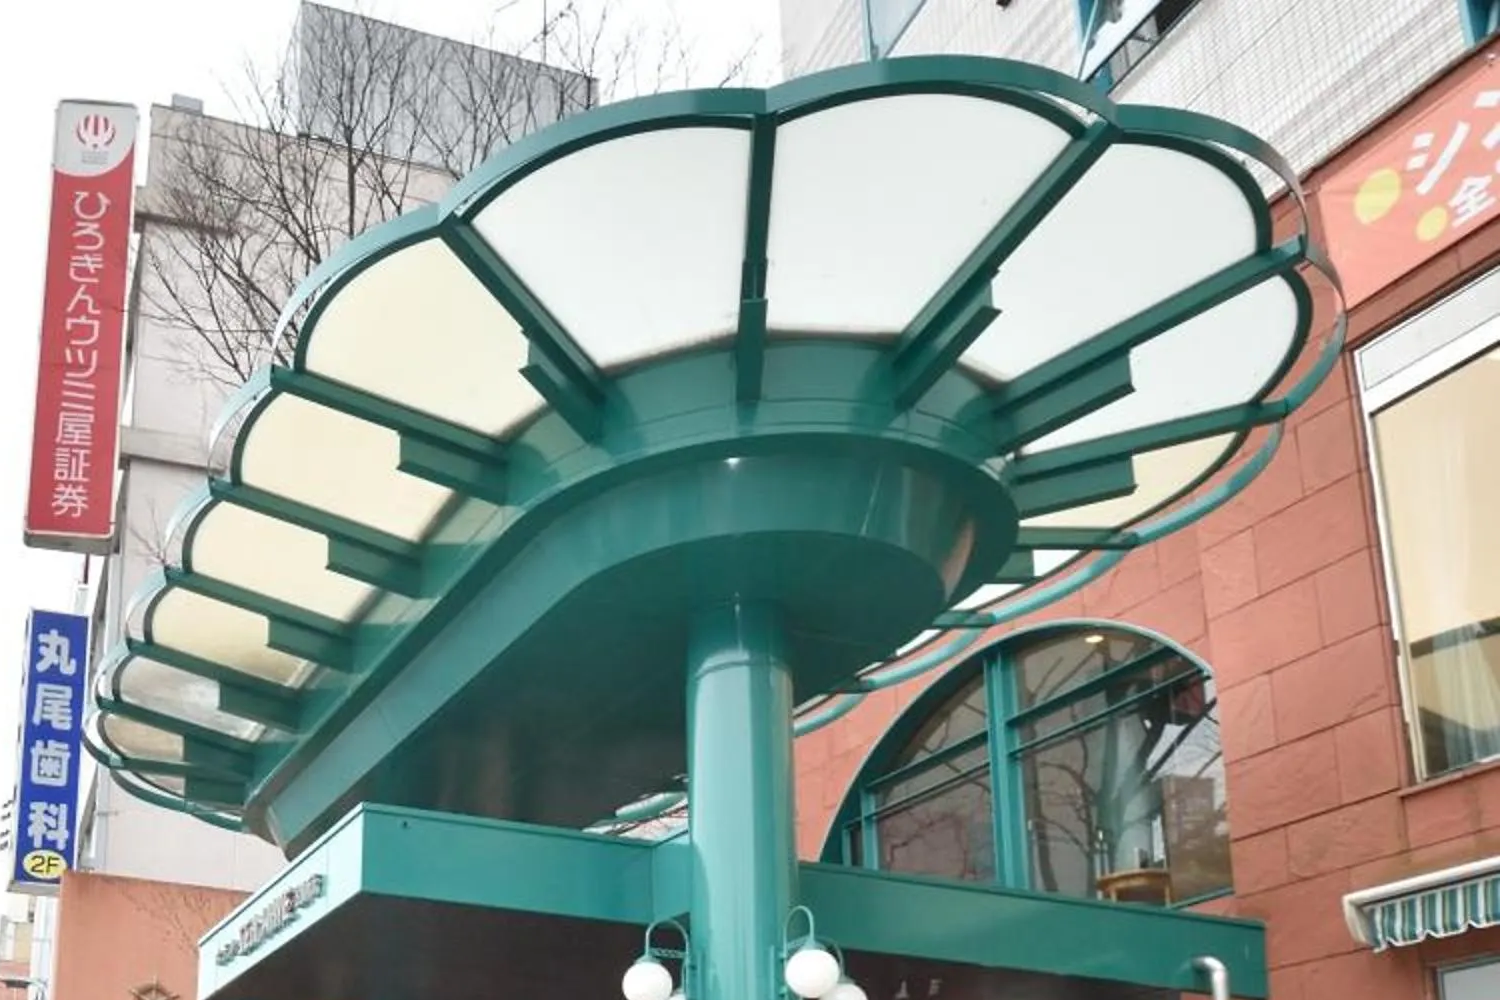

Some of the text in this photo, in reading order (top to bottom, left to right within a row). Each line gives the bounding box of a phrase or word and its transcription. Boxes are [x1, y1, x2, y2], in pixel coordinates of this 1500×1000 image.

[51, 190, 112, 519] ひろぎんウツミ屋証券
[26, 628, 78, 851] 丸尾歯科
[30, 854, 61, 874] 2F
